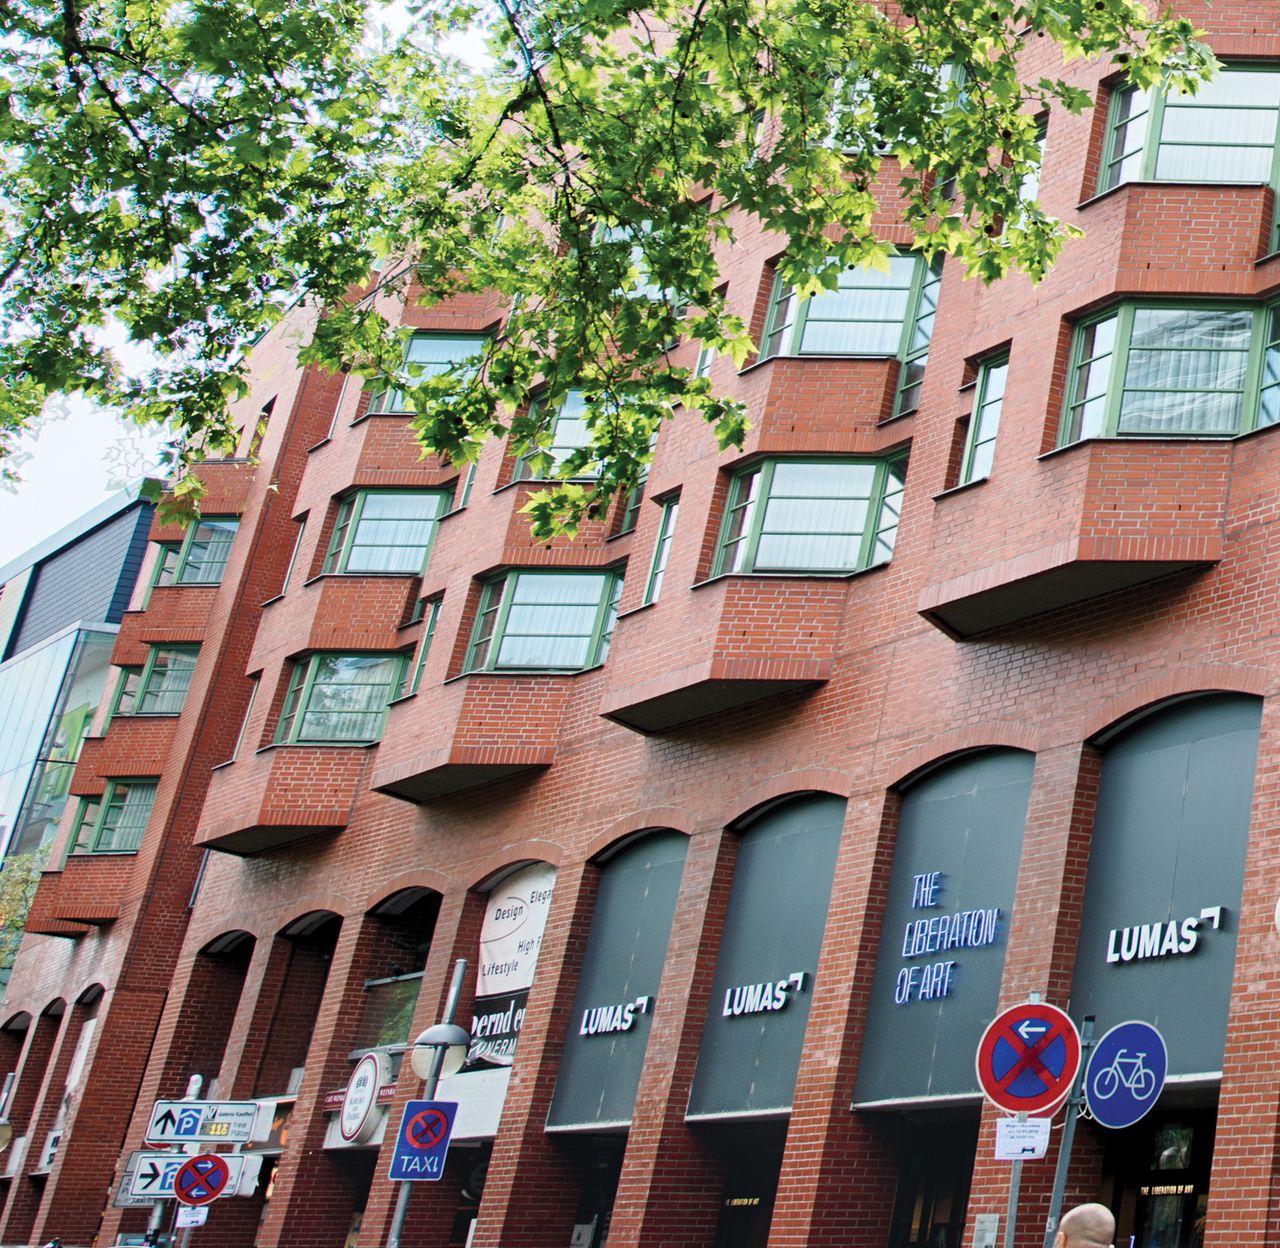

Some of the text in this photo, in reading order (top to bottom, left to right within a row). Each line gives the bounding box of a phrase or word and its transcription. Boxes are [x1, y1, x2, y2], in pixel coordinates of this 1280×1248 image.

[912, 871, 942, 909] THE
[495, 905, 523, 921] Design
[518, 937, 534, 955] High
[902, 907, 999, 957] LIBERATION
[1106, 917, 1198, 963] LUMAS
[482, 960, 519, 977] Lifestyle
[895, 961, 955, 1004] OF ART
[722, 980, 788, 1017] LUMAS
[579, 1003, 636, 1035] LUMAS
[401, 1156, 439, 1173] TAXI
[1151, 1185, 1177, 1195] LIBERATION
[1184, 1184, 1194, 1194] ART
